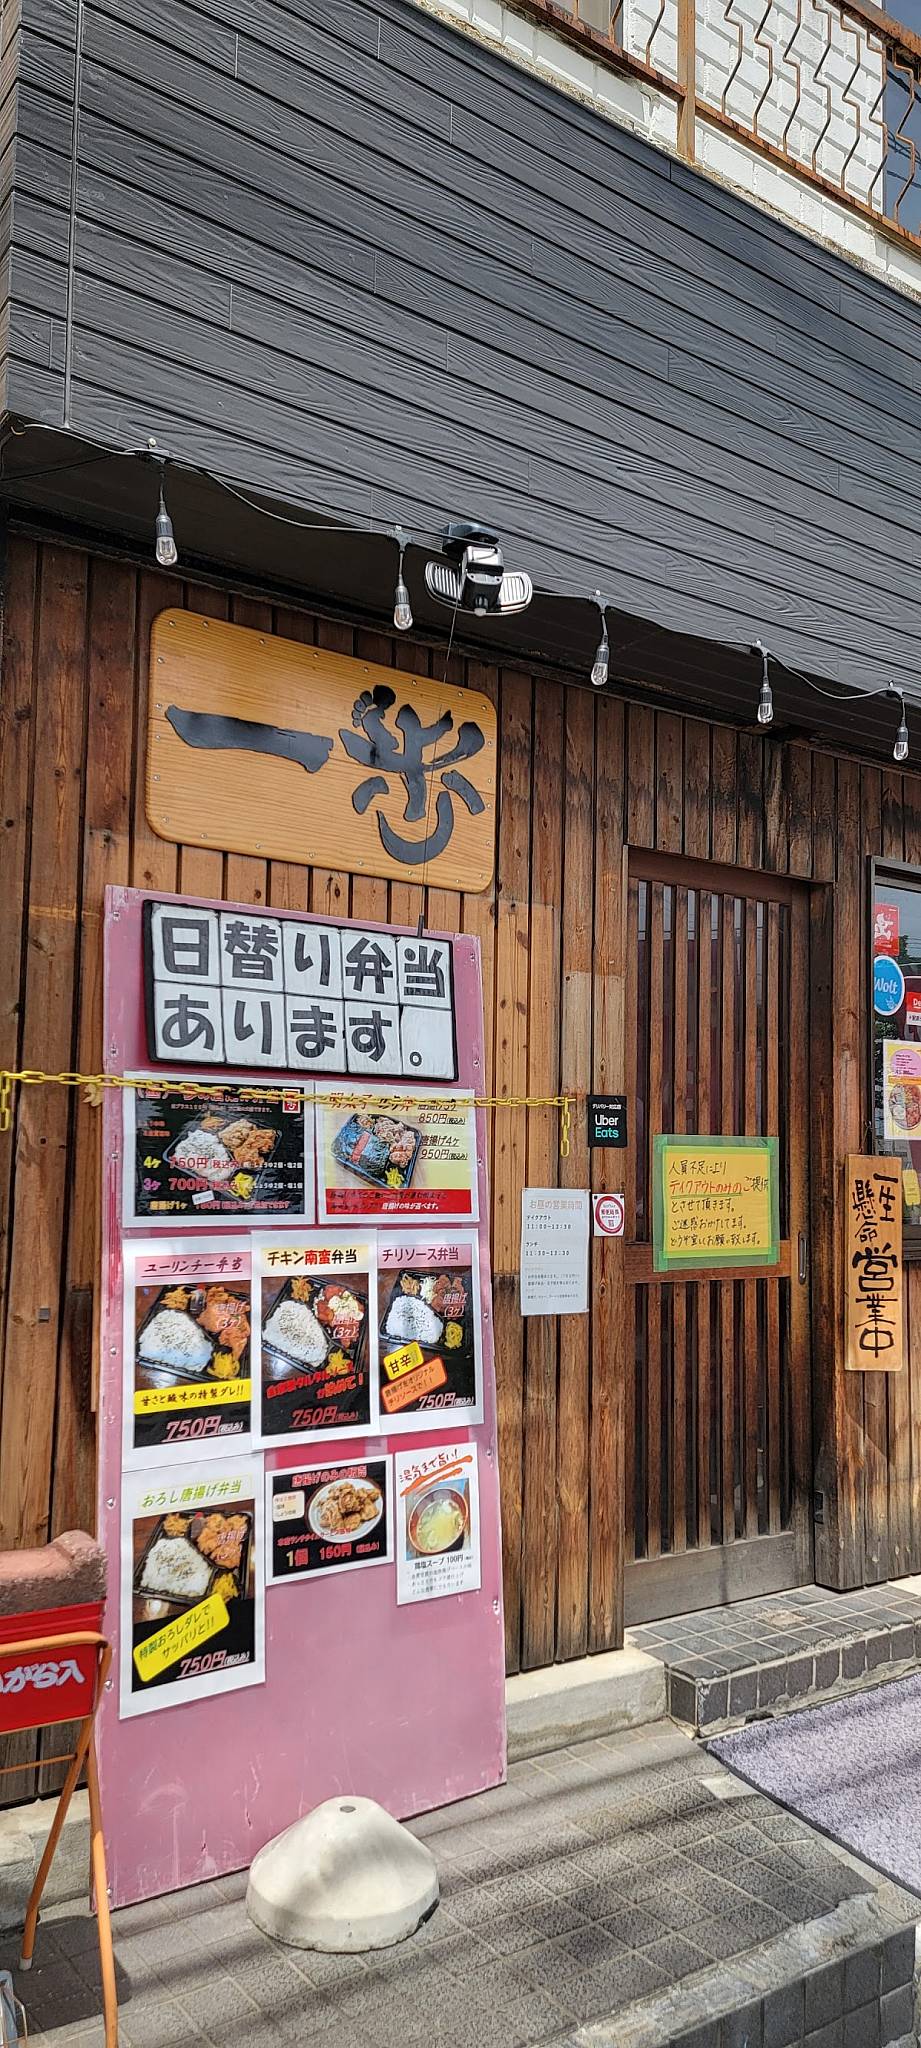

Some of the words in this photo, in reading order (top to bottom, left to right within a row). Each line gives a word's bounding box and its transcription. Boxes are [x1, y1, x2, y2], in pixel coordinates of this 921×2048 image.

[161, 917, 446, 998] 日替り弁当
[874, 975, 899, 995] Wolt
[161, 994, 422, 1067] あります。
[594, 1114, 619, 1126] Uber
[595, 1126, 619, 1139] Eats
[266, 1249, 358, 1266] チキン南蛮弁当
[382, 1246, 460, 1262] チリソース弁当
[144, 1257, 243, 1273] ユーリンチー弁当
[141, 1479, 242, 1508] おろし唐揚げ弁当
